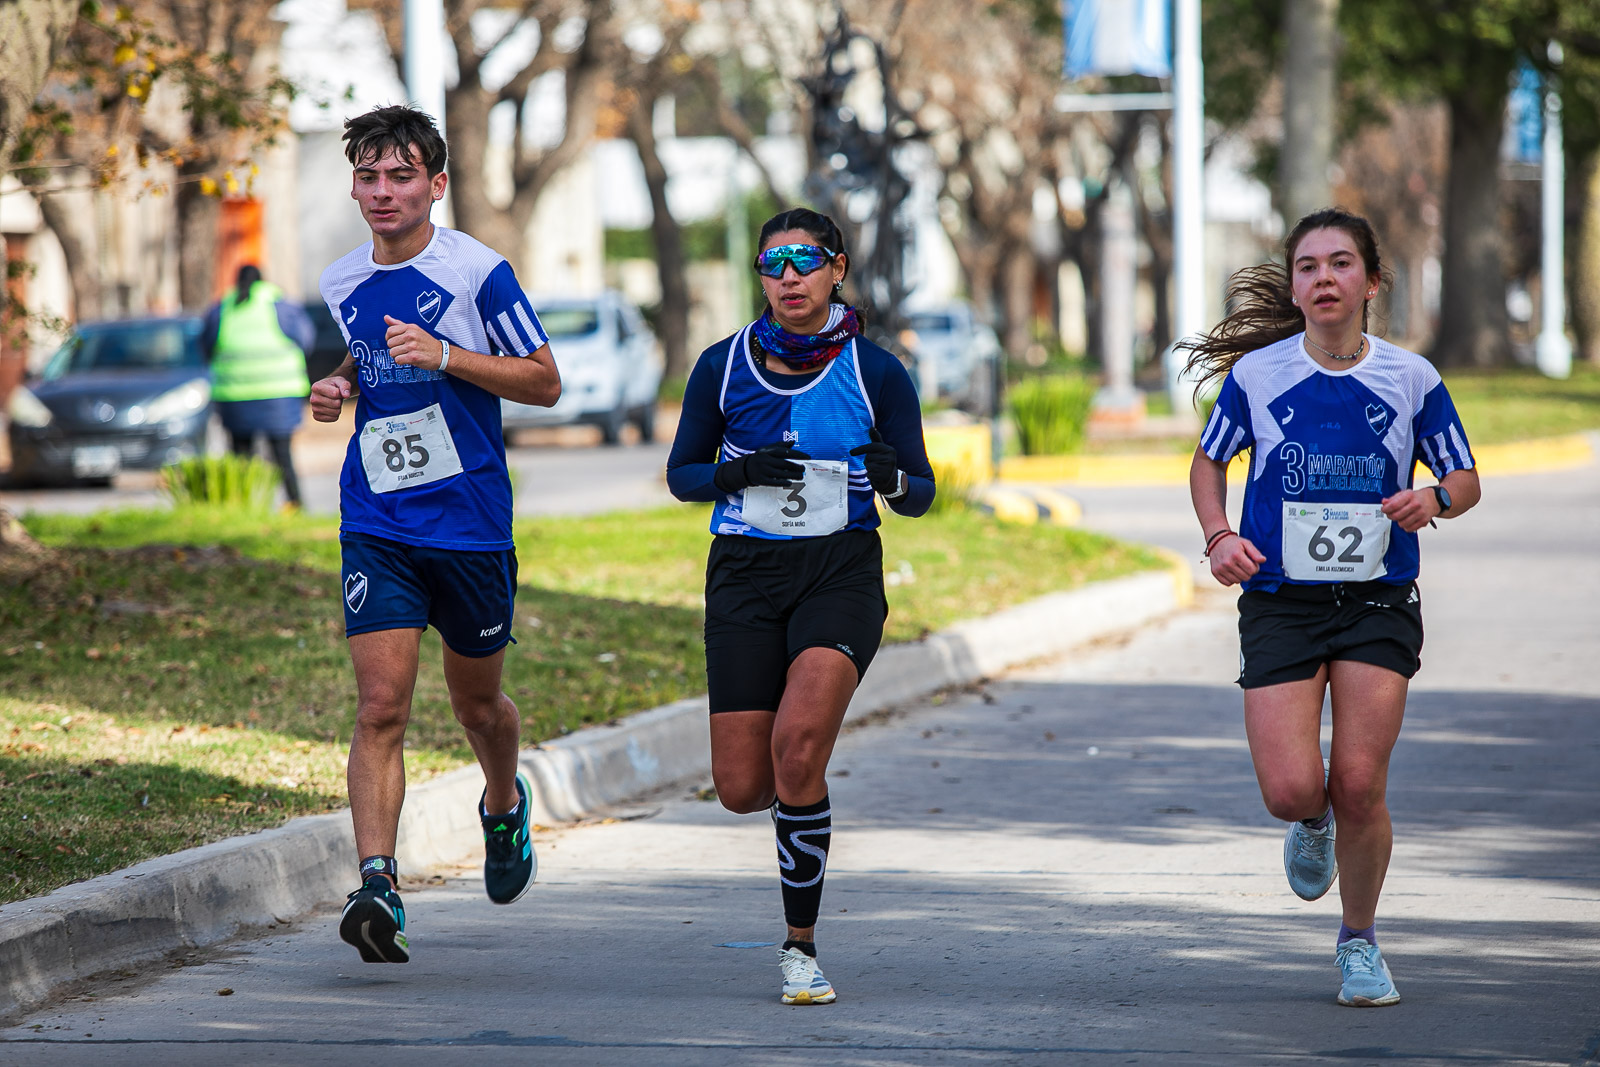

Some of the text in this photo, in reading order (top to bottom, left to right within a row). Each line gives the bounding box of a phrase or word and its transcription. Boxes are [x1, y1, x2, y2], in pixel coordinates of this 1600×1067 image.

[351, 339, 379, 388] 3
[382, 433, 430, 473] 85
[1280, 442, 1305, 495] 3
[1307, 453, 1386, 479] MARATÓN
[780, 481, 807, 518] 3
[1322, 507, 1330, 521] 3
[1308, 525, 1364, 563] 62
[480, 622, 503, 637] KION
